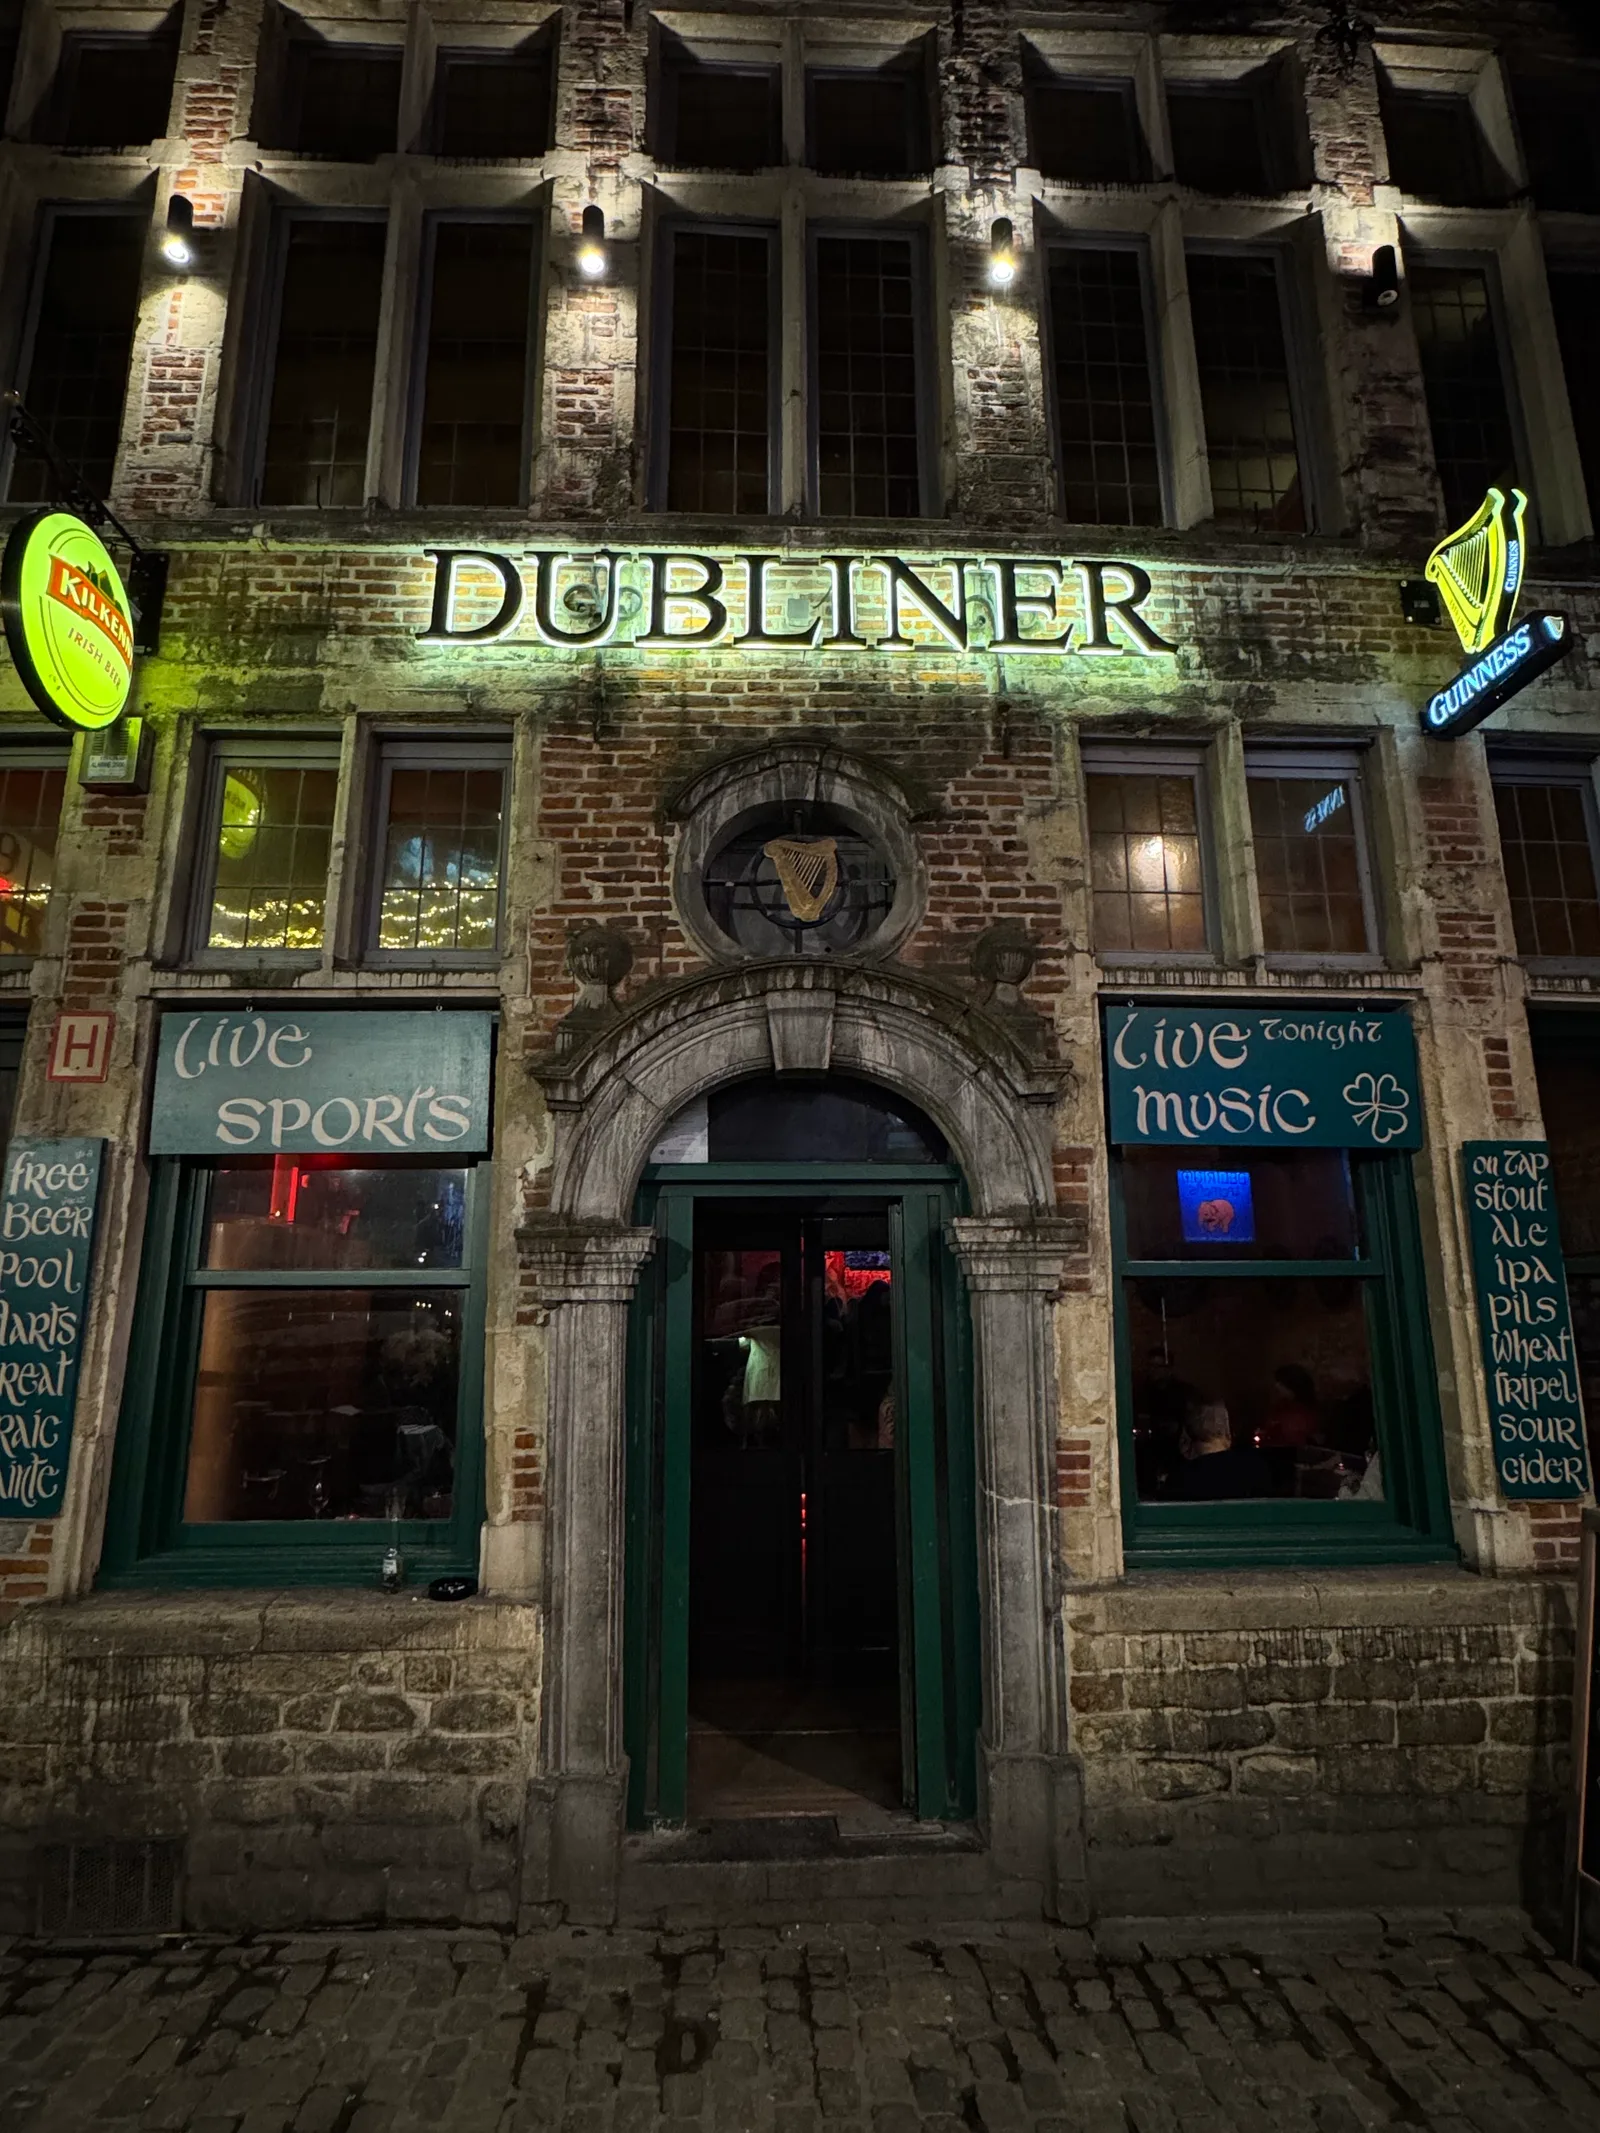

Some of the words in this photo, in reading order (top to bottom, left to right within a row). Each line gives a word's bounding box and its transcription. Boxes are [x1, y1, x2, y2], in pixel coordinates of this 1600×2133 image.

[414, 548, 1179, 655] DUBLINER
[1504, 539, 1520, 593] GUINNESS
[60, 567, 133, 666] KILKENN
[67, 627, 103, 665] IRISH
[104, 659, 121, 691] BEER
[1429, 626, 1530, 725] GUINNESS
[63, 1024, 97, 1068] H
